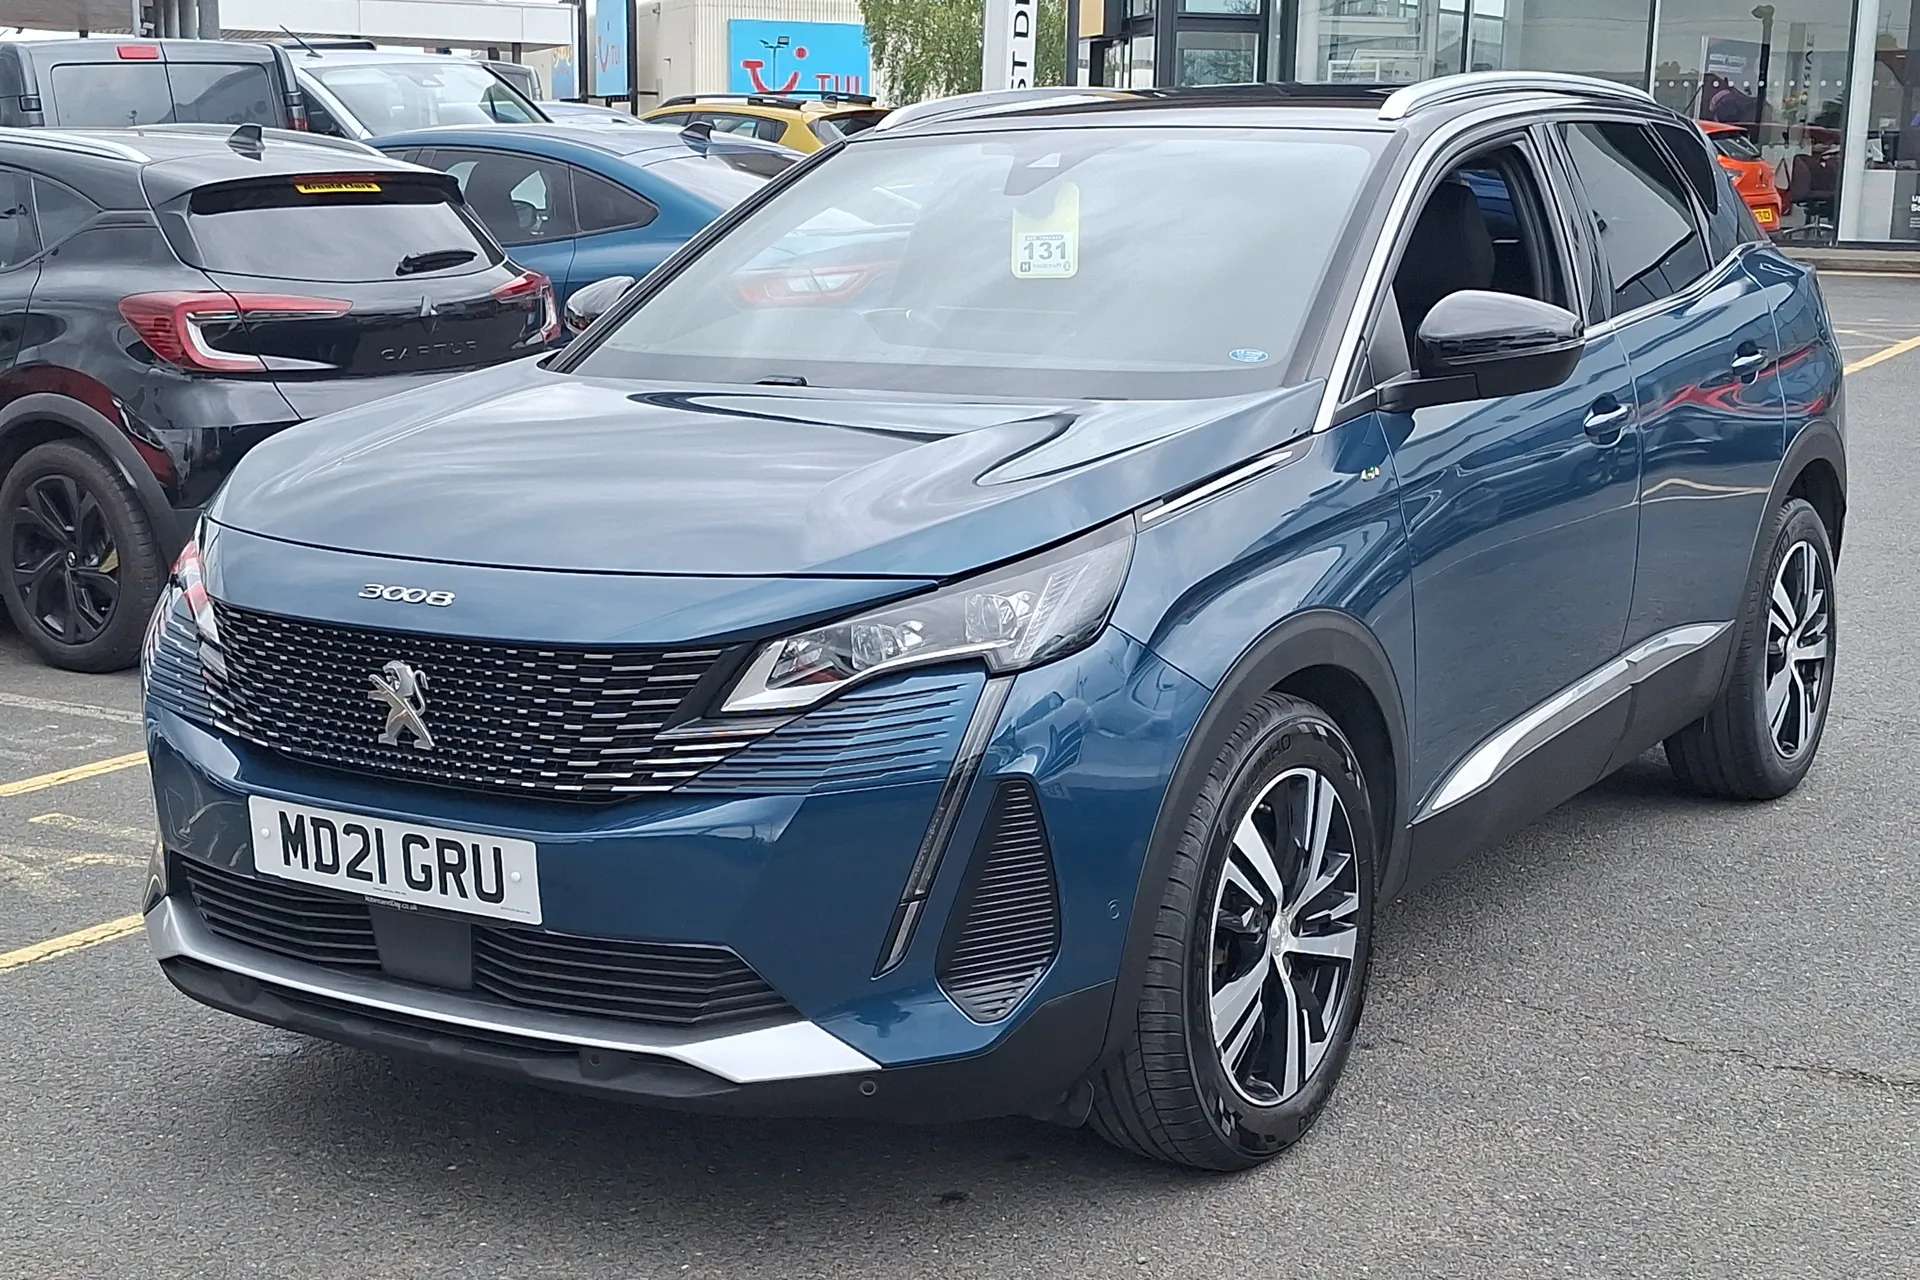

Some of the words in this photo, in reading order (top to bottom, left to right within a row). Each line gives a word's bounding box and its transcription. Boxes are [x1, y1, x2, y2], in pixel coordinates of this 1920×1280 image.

[1023, 241, 1066, 260] 131
[357, 583, 456, 607] 3008
[278, 810, 388, 885] MD21
[401, 832, 505, 904] GRU
